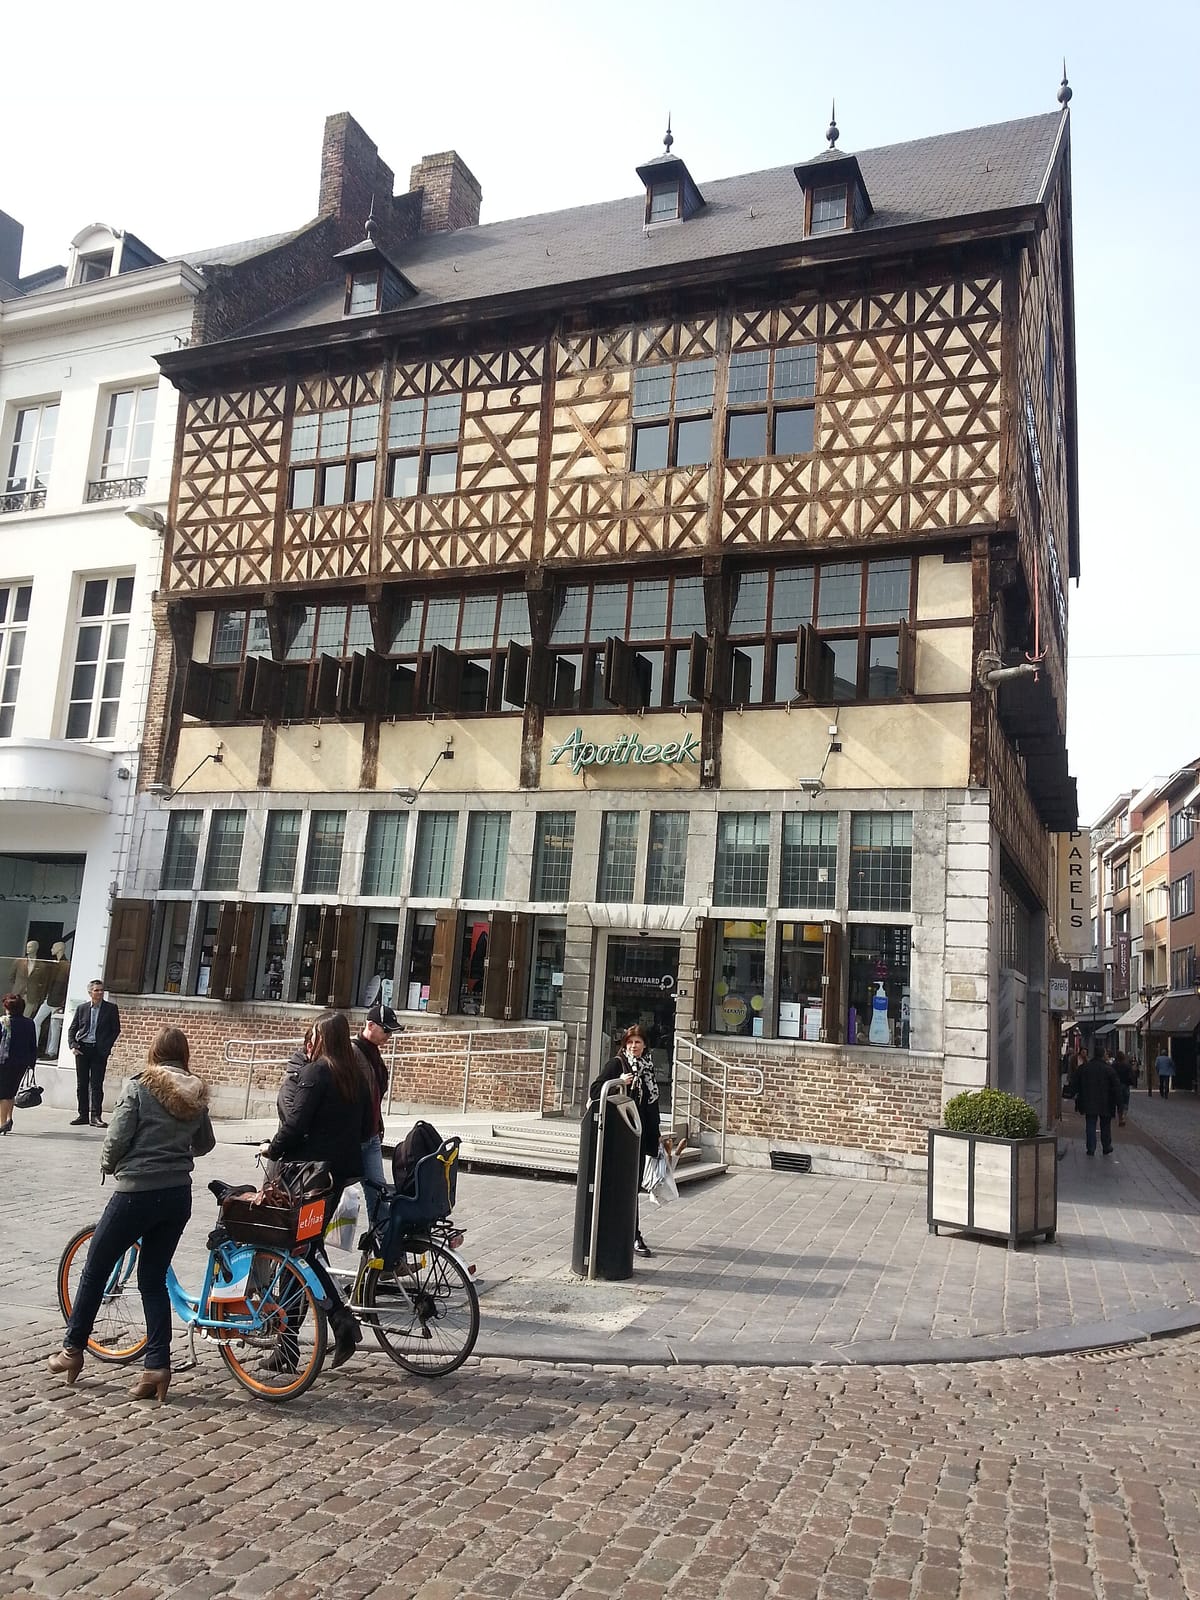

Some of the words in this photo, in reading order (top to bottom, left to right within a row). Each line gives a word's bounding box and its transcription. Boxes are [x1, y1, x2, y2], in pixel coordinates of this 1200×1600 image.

[548, 727, 701, 775] Apotheek
[1069, 831, 1083, 928] PARELS
[634, 976, 660, 985] ZWAARD
[1049, 979, 1068, 992] Parels
